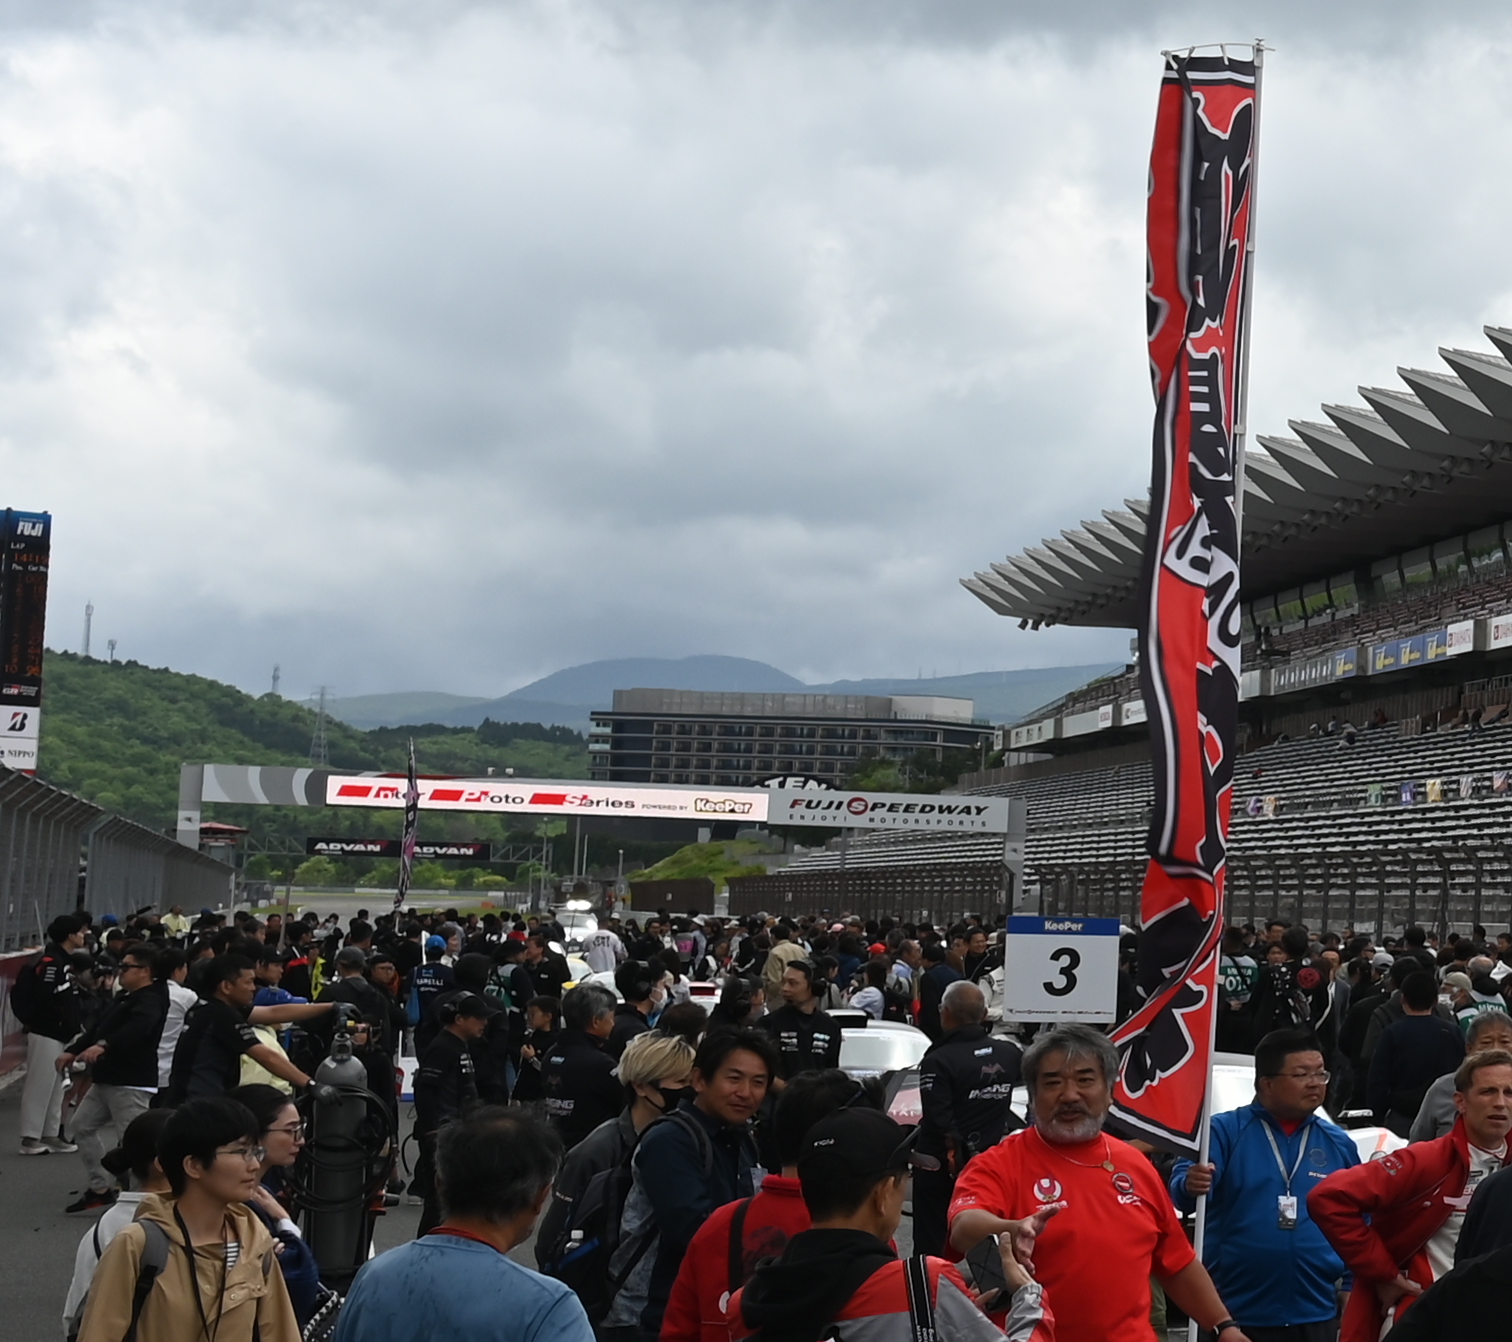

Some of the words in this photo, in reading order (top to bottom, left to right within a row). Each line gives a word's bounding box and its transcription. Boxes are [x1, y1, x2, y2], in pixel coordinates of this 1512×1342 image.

[17, 521, 43, 537] FUJI
[8, 748, 35, 759] NIPPO
[694, 797, 752, 815] KeePer
[789, 799, 844, 812] FUJI
[846, 797, 989, 817] SPEEDWAY
[869, 816, 987, 828] MOTORSPORTS
[314, 841, 381, 853] ADVAN
[412, 846, 474, 856] ADVAN
[1044, 921, 1083, 932] KeePer
[1043, 947, 1081, 997] 3
